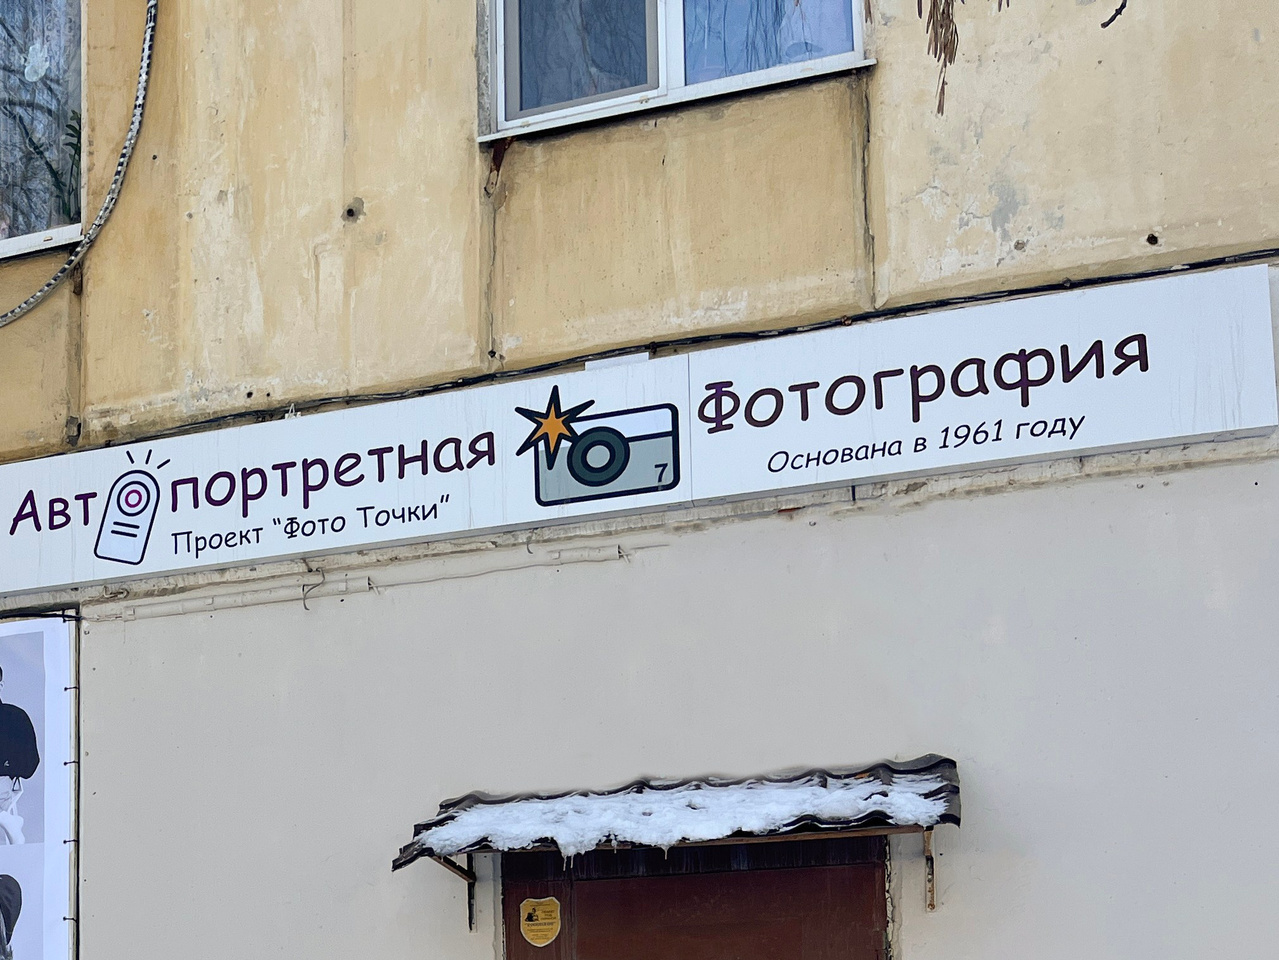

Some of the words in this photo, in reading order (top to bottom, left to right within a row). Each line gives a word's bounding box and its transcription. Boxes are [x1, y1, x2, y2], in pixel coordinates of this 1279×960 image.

[697, 333, 1149, 435] Фотография
[654, 462, 669, 483] 7
[767, 440, 903, 473] Основана
[913, 436, 927, 453] в
[938, 419, 1003, 450] 1961
[1014, 414, 1086, 441] году
[170, 527, 264, 559] Проект
[272, 515, 346, 540] "Фото
[355, 493, 450, 529] Точки"
